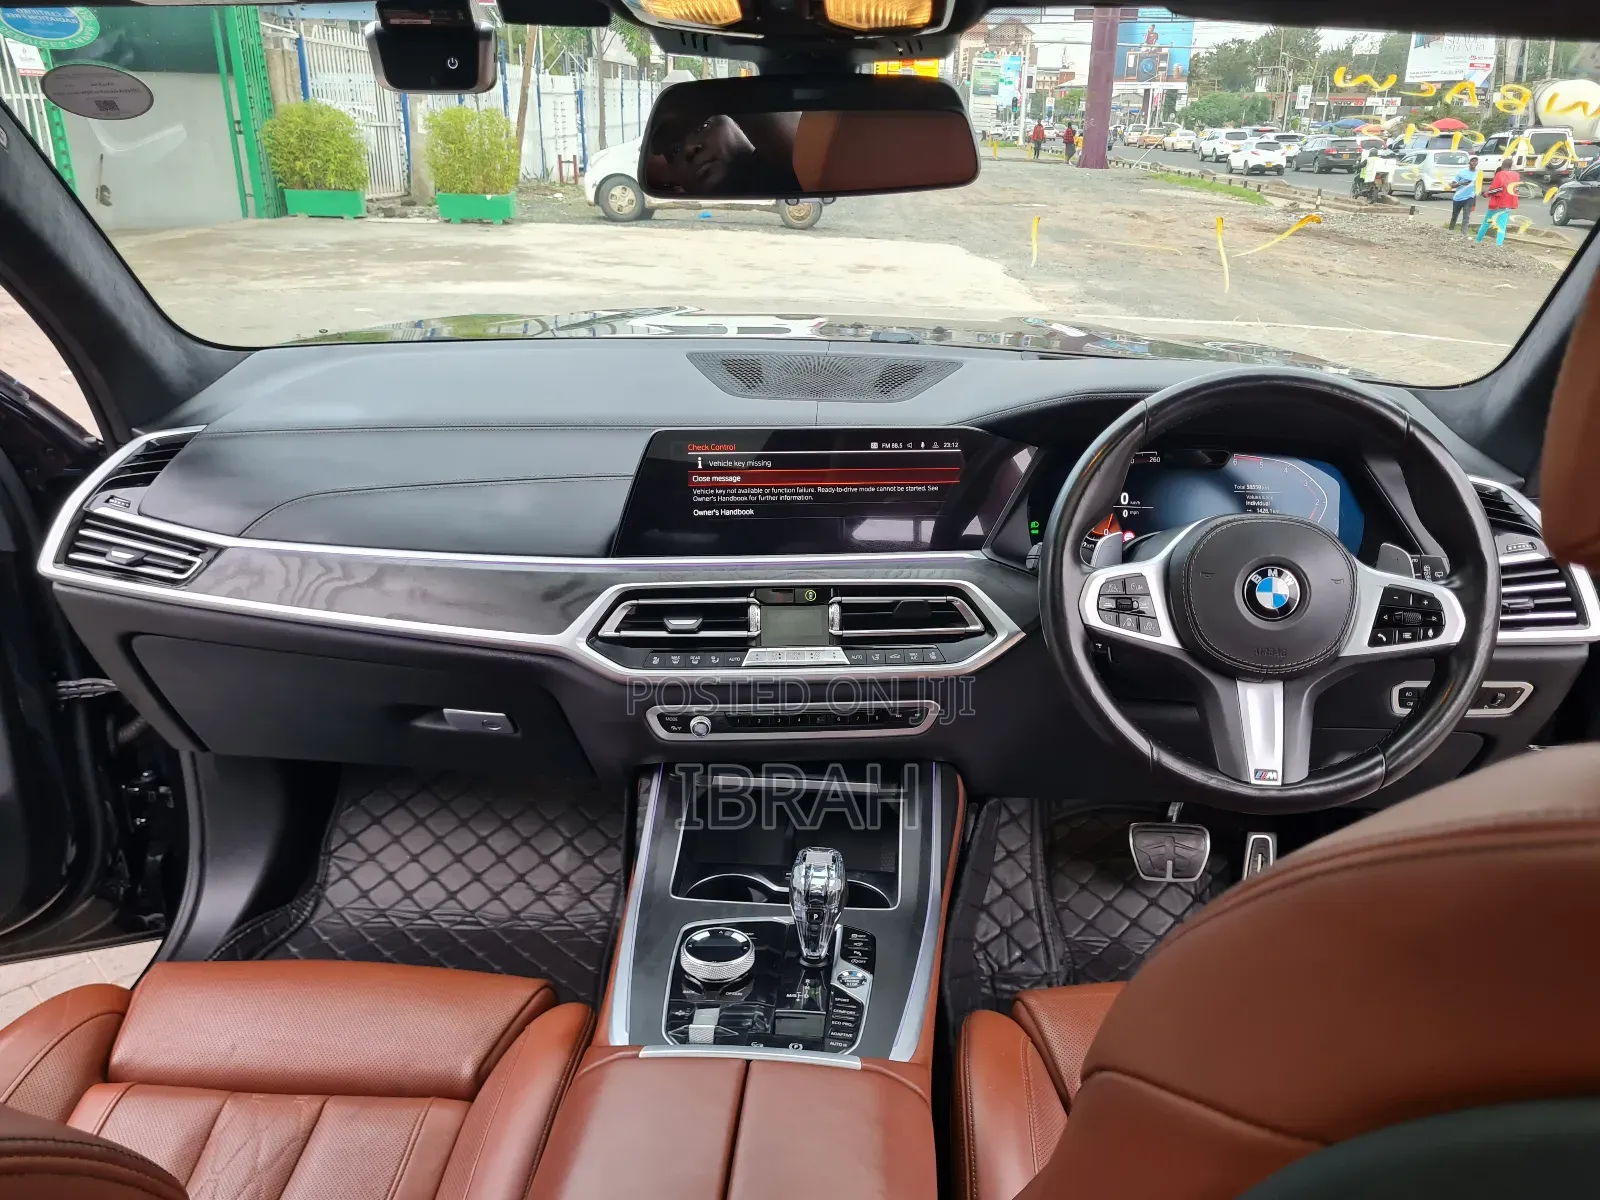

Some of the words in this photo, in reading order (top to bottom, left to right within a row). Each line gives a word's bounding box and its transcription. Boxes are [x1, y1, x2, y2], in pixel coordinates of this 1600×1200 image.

[734, 460, 745, 469] key
[747, 460, 772, 468] missing
[1284, 466, 1288, 474] 4
[712, 475, 741, 483] message
[1120, 492, 1129, 505] 0
[720, 508, 754, 516] Handbook
[1123, 510, 1128, 518] 0
[1103, 528, 1109, 536] 0
[1251, 569, 1295, 586] BMW
